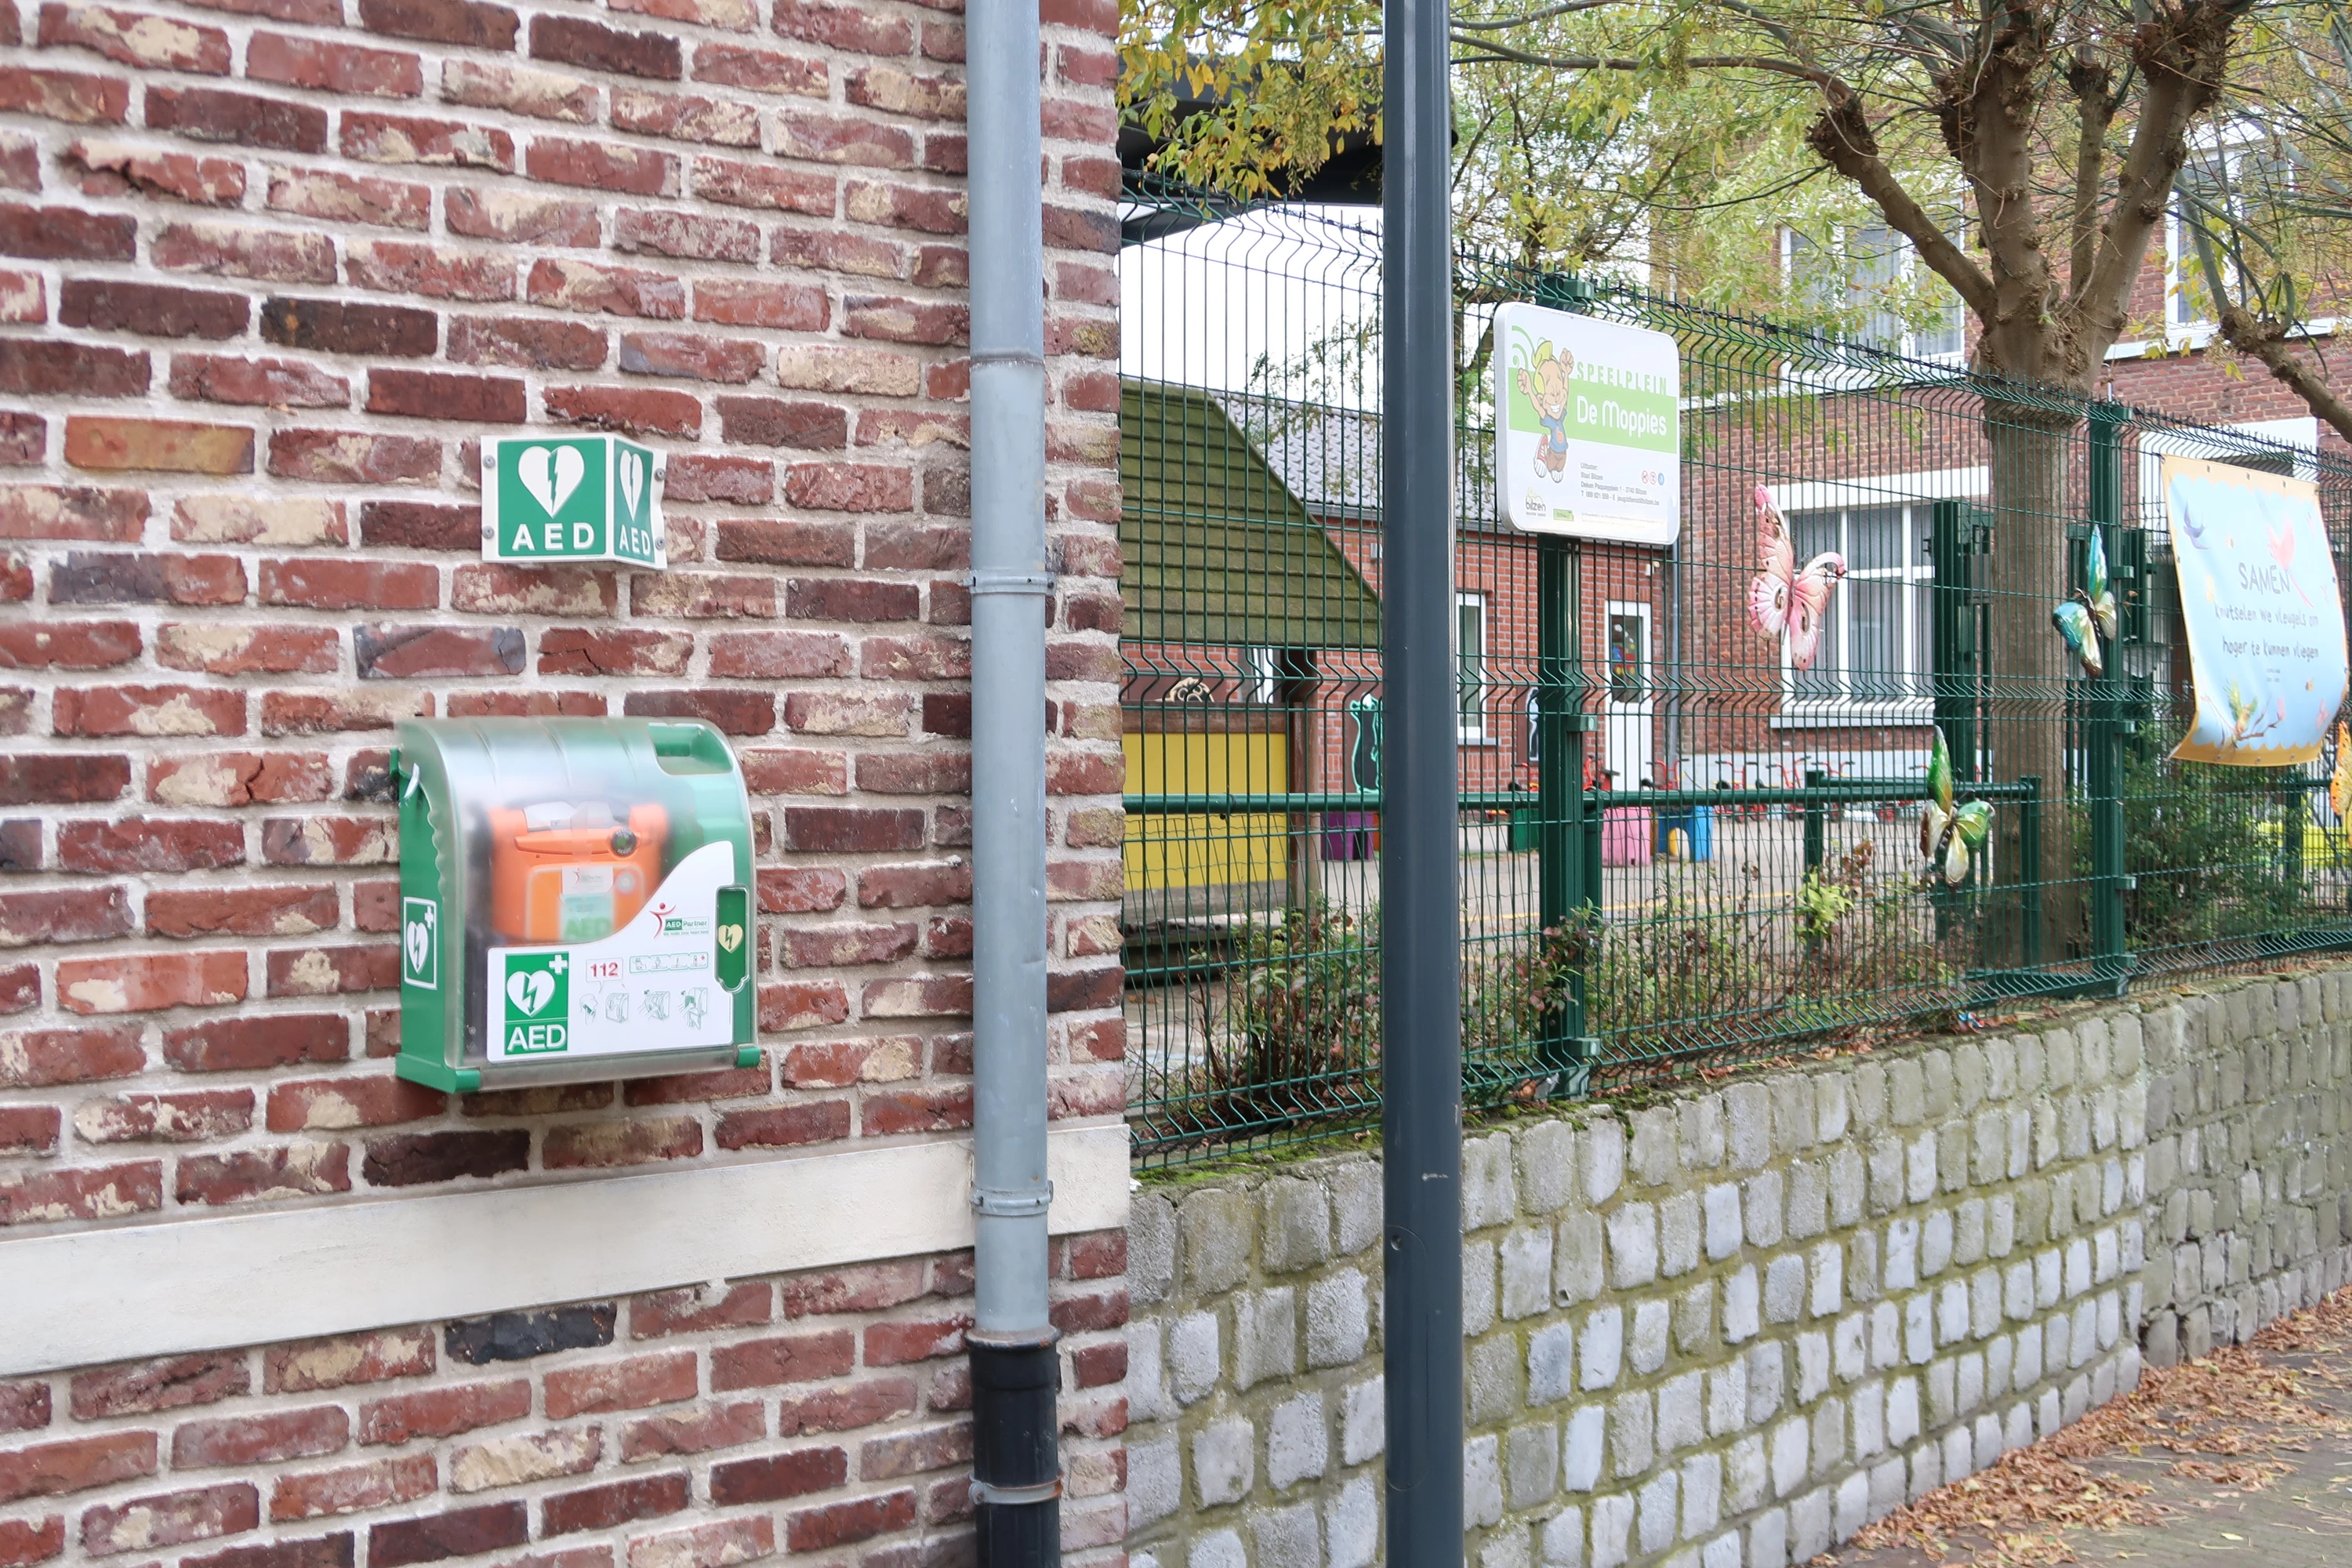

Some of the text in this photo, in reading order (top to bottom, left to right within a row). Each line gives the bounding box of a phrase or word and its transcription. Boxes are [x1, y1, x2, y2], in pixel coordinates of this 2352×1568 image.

[1577, 361, 1667, 396] SPEELPLEIN
[1577, 395, 1667, 438] De Moppies
[511, 522, 595, 551] AED
[619, 524, 651, 557] AED
[2238, 561, 2291, 596] SAMEN
[2214, 603, 2257, 622] knutselen
[2222, 635, 2319, 662] hoger te kunnen vliegen
[590, 961, 619, 978] 112
[507, 1024, 567, 1052] AED
